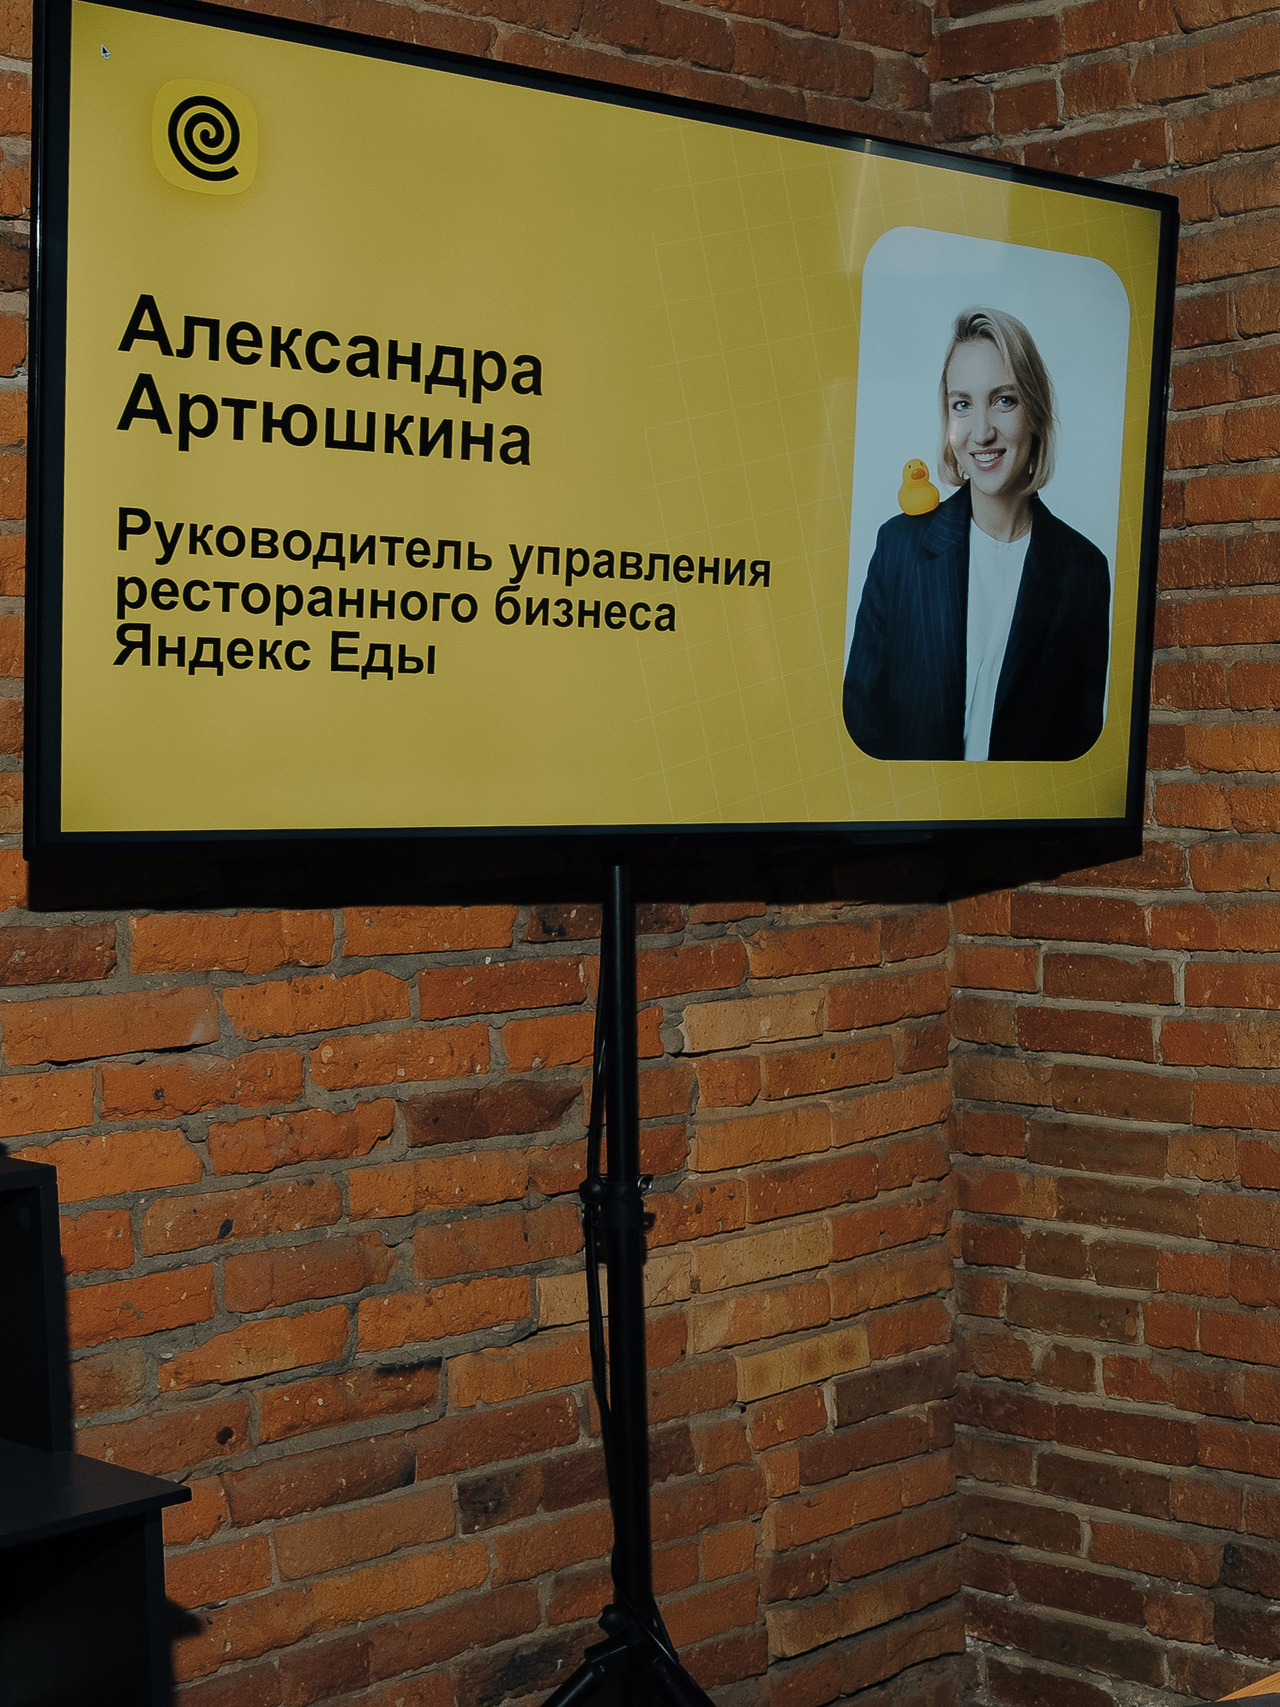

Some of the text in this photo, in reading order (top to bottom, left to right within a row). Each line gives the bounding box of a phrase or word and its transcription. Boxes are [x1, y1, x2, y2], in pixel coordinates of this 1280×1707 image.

[117, 293, 543, 404] Александра
[116, 372, 531, 466] Артюшкина
[118, 506, 771, 588] Руководитель управления
[116, 576, 677, 632] ресторанного бизнеса
[112, 622, 436, 681] Яндекс Еды
